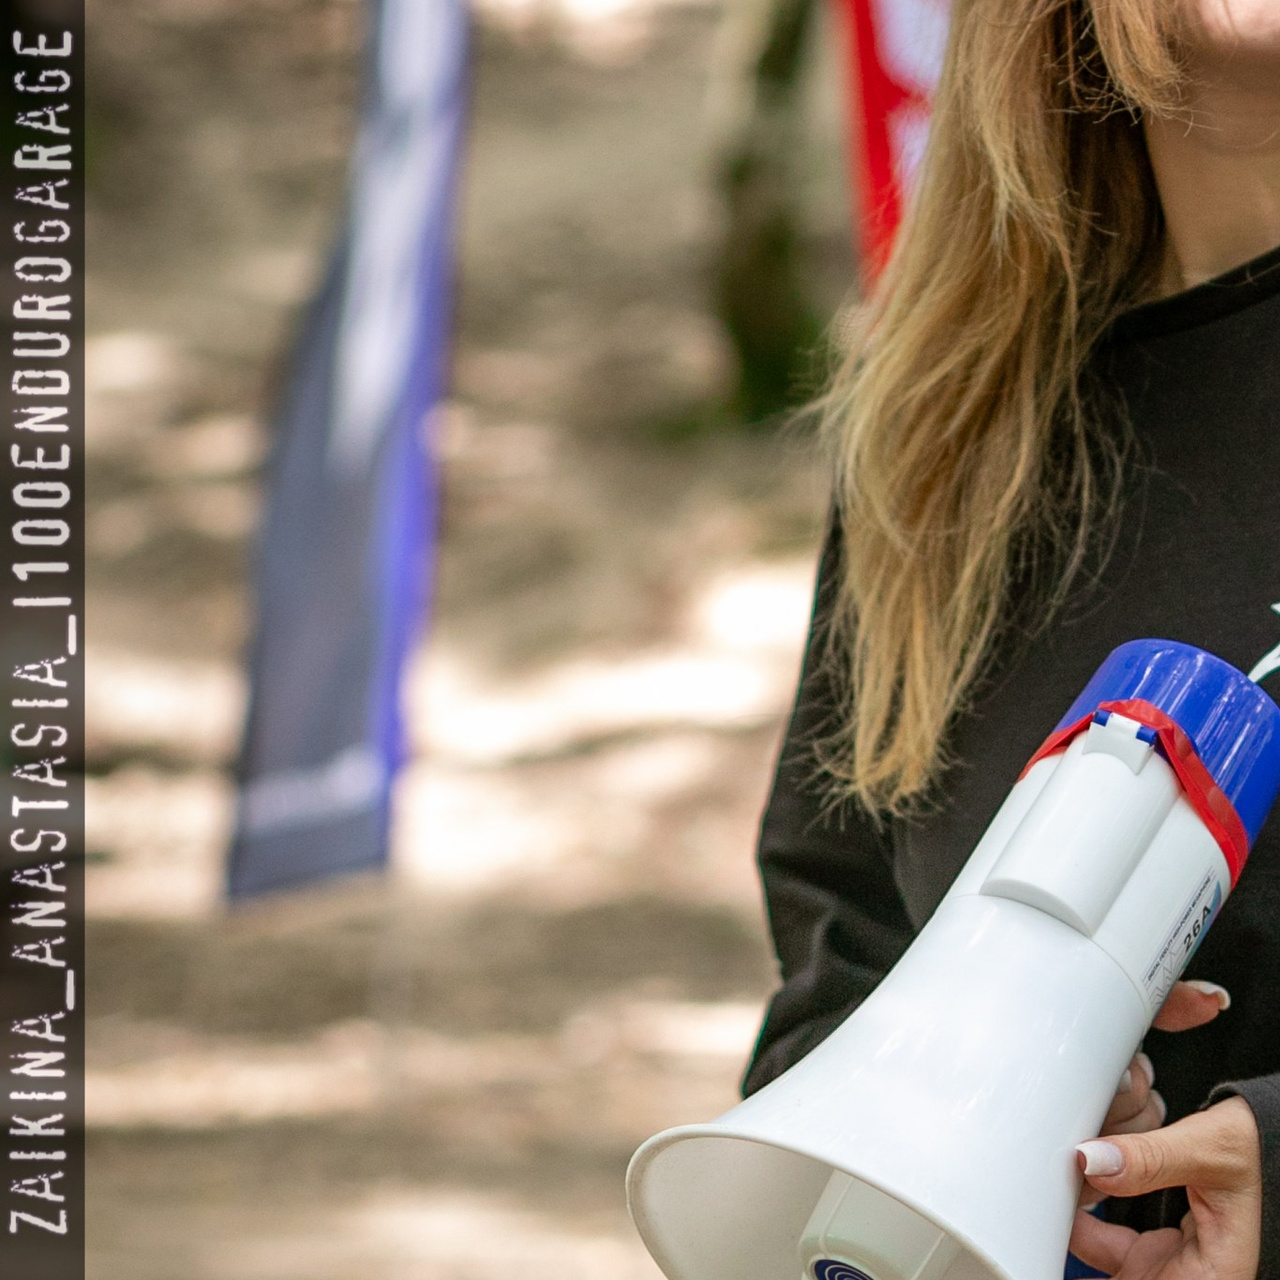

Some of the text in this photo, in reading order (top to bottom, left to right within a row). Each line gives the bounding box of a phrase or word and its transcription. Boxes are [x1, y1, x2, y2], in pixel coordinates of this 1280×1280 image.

[1148, 961, 1160, 980] DIGITAL
[1159, 939, 1173, 961] FIDELITY
[1191, 876, 1211, 907] MEGAPHONE
[1183, 905, 1211, 953] 26A
